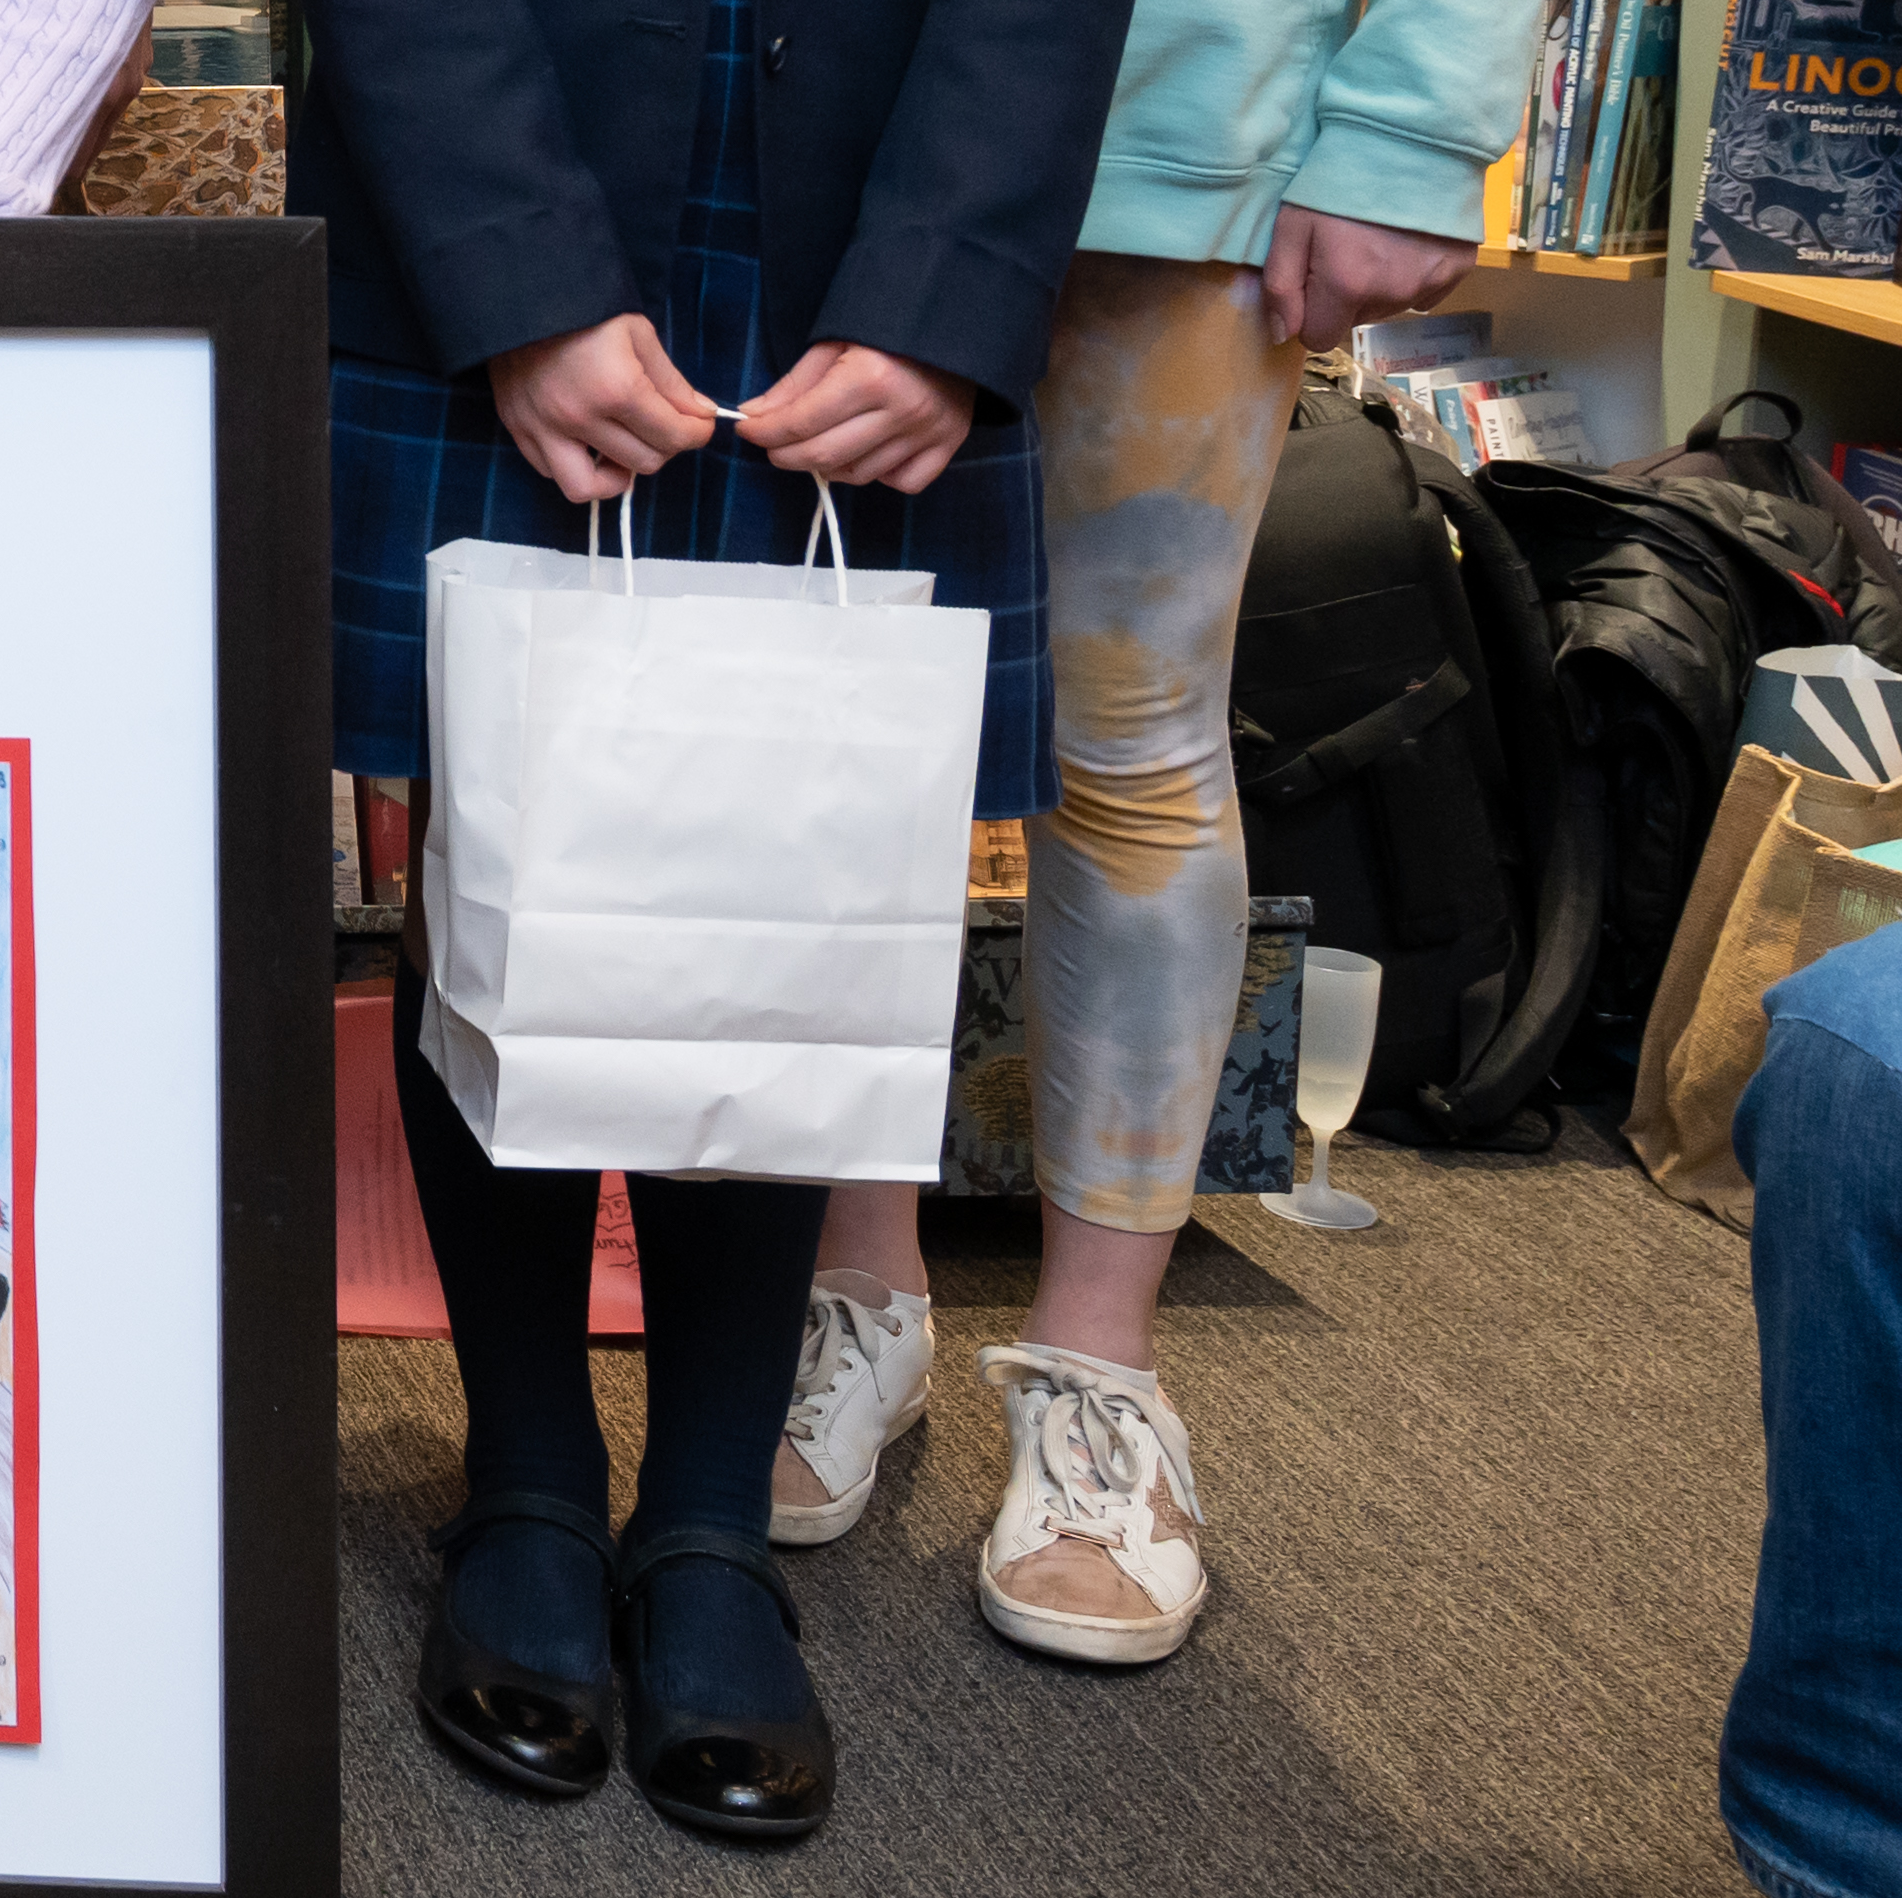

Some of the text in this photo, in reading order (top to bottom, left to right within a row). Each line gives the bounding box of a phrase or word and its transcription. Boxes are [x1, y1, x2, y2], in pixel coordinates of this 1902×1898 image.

[1749, 52, 1902, 97] LINO
[1606, 79, 1622, 106] Bible
[1766, 99, 1897, 119] A Creative Guide
[1555, 48, 1580, 177] ACRYLIC PAINTING TECHNIQUES
[1810, 119, 1880, 136] Beautiful
[1694, 127, 1717, 222] Sam Marshall
[1797, 247, 1829, 262] Sam
[1486, 418, 1505, 458] PAINT
